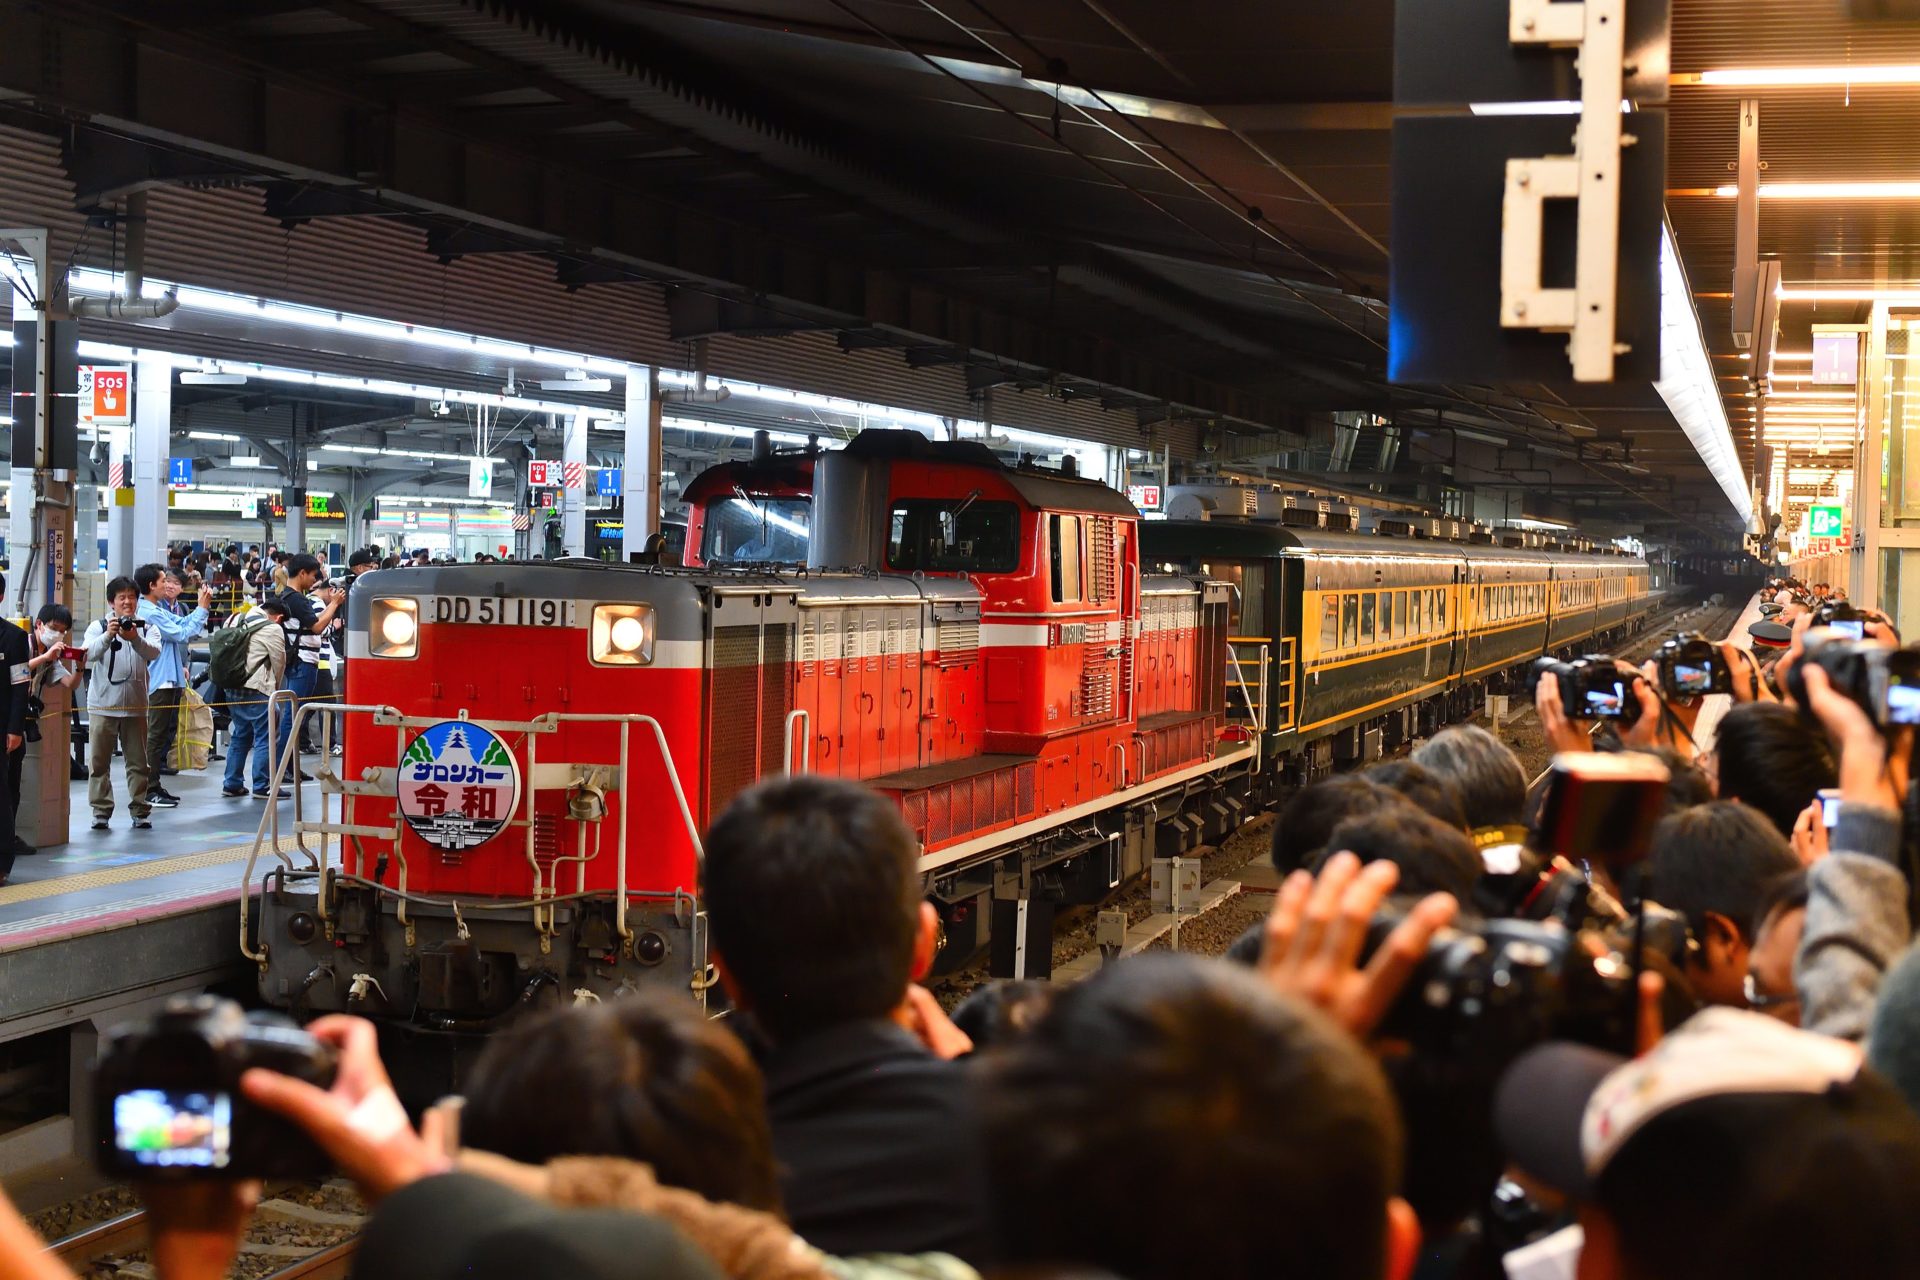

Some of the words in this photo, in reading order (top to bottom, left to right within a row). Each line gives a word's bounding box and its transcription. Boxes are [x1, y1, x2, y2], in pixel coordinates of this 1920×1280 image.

[1827, 341, 1839, 369] 1
[97, 377, 123, 389] SOS
[177, 459, 184, 477] 1
[605, 470, 612, 487] 1
[56, 533, 64, 591] おおさか
[518, 599, 567, 627] 1191
[413, 763, 508, 784] サロンカー
[414, 784, 497, 819] 令和
